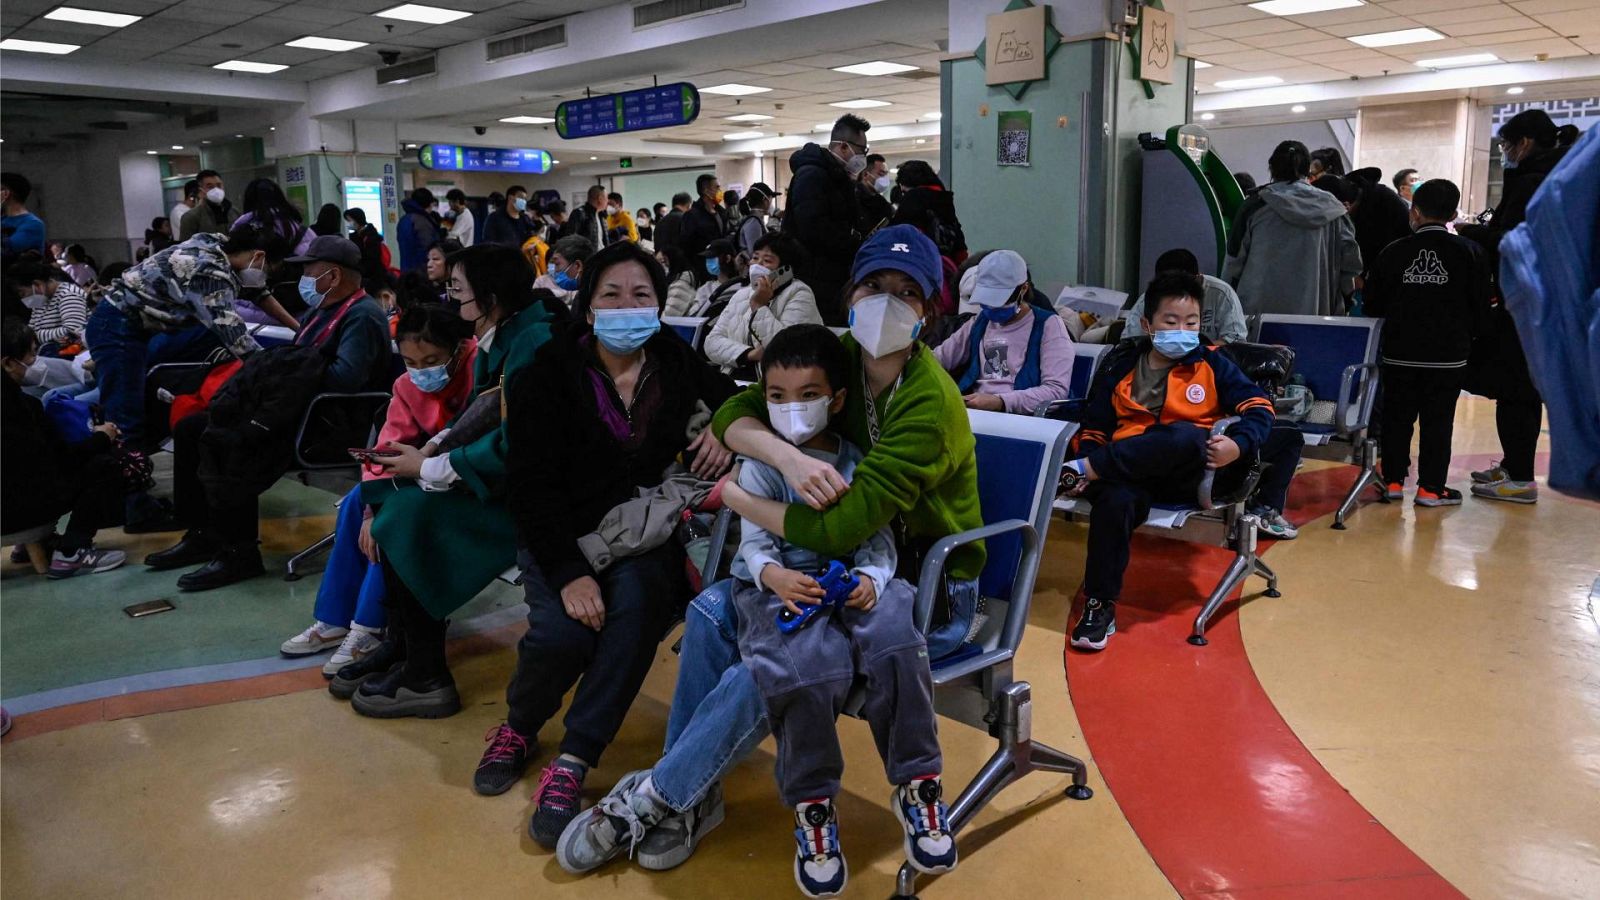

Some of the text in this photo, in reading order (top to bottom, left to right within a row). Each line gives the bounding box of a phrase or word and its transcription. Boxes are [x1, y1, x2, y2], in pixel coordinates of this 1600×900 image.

[891, 243, 910, 252] R
[1402, 274, 1448, 285] Kapap
[82, 554, 97, 565] N
